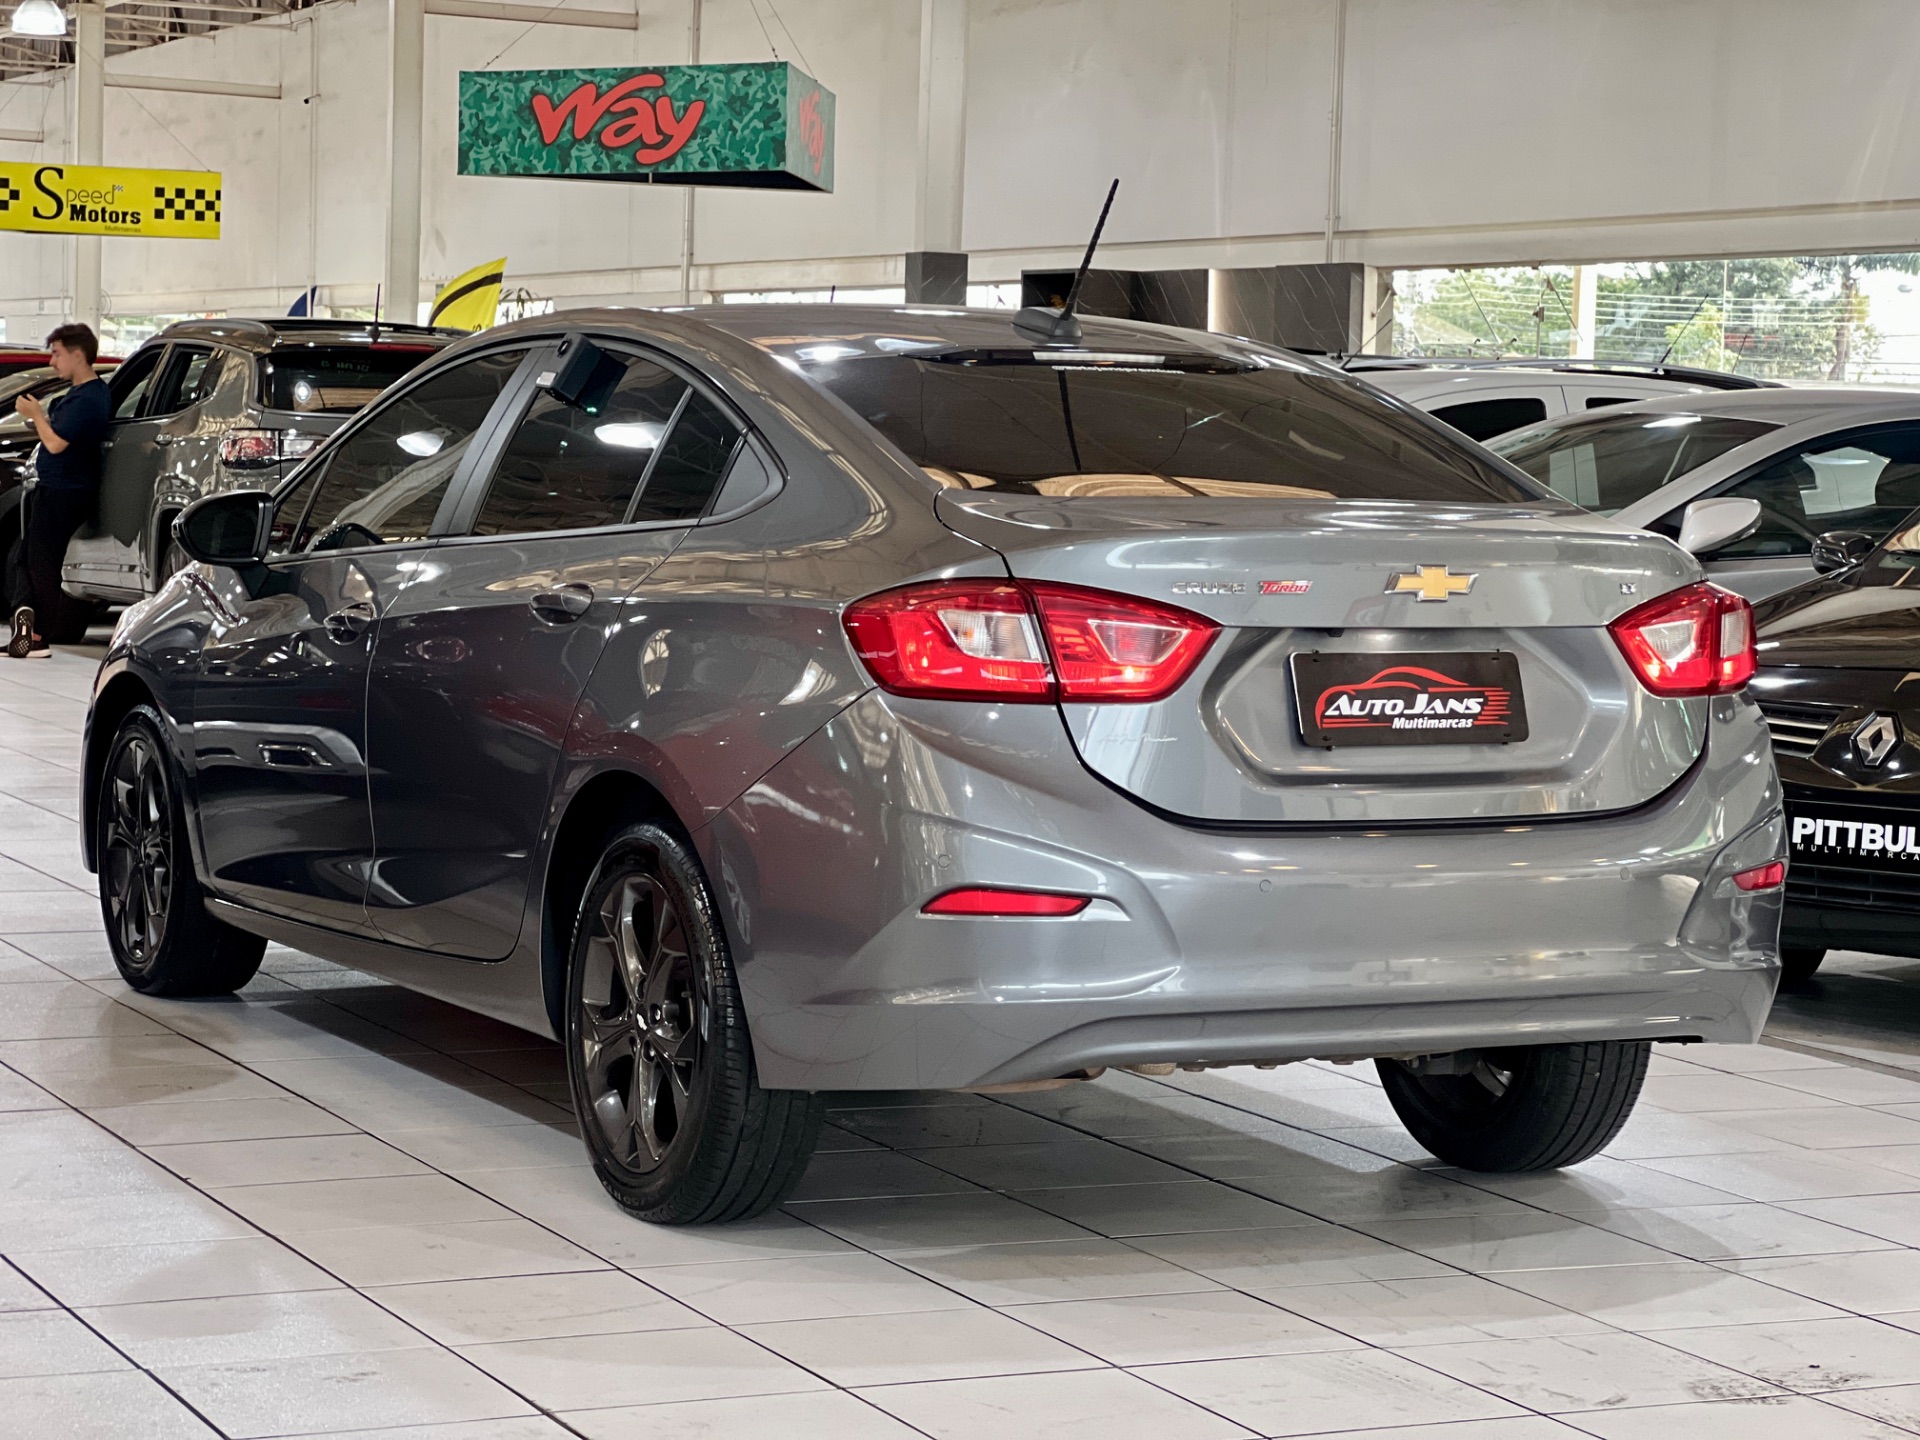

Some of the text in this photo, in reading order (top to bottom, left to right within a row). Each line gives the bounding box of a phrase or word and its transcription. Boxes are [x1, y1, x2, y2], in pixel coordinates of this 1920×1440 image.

[532, 73, 706, 165] Way
[33, 167, 115, 220] Speed
[69, 204, 141, 224] Motors
[1171, 581, 1247, 595] CRUZE
[1392, 717, 1474, 730] Multimarcas
[1796, 843, 1920, 861] MULTIMARCA
